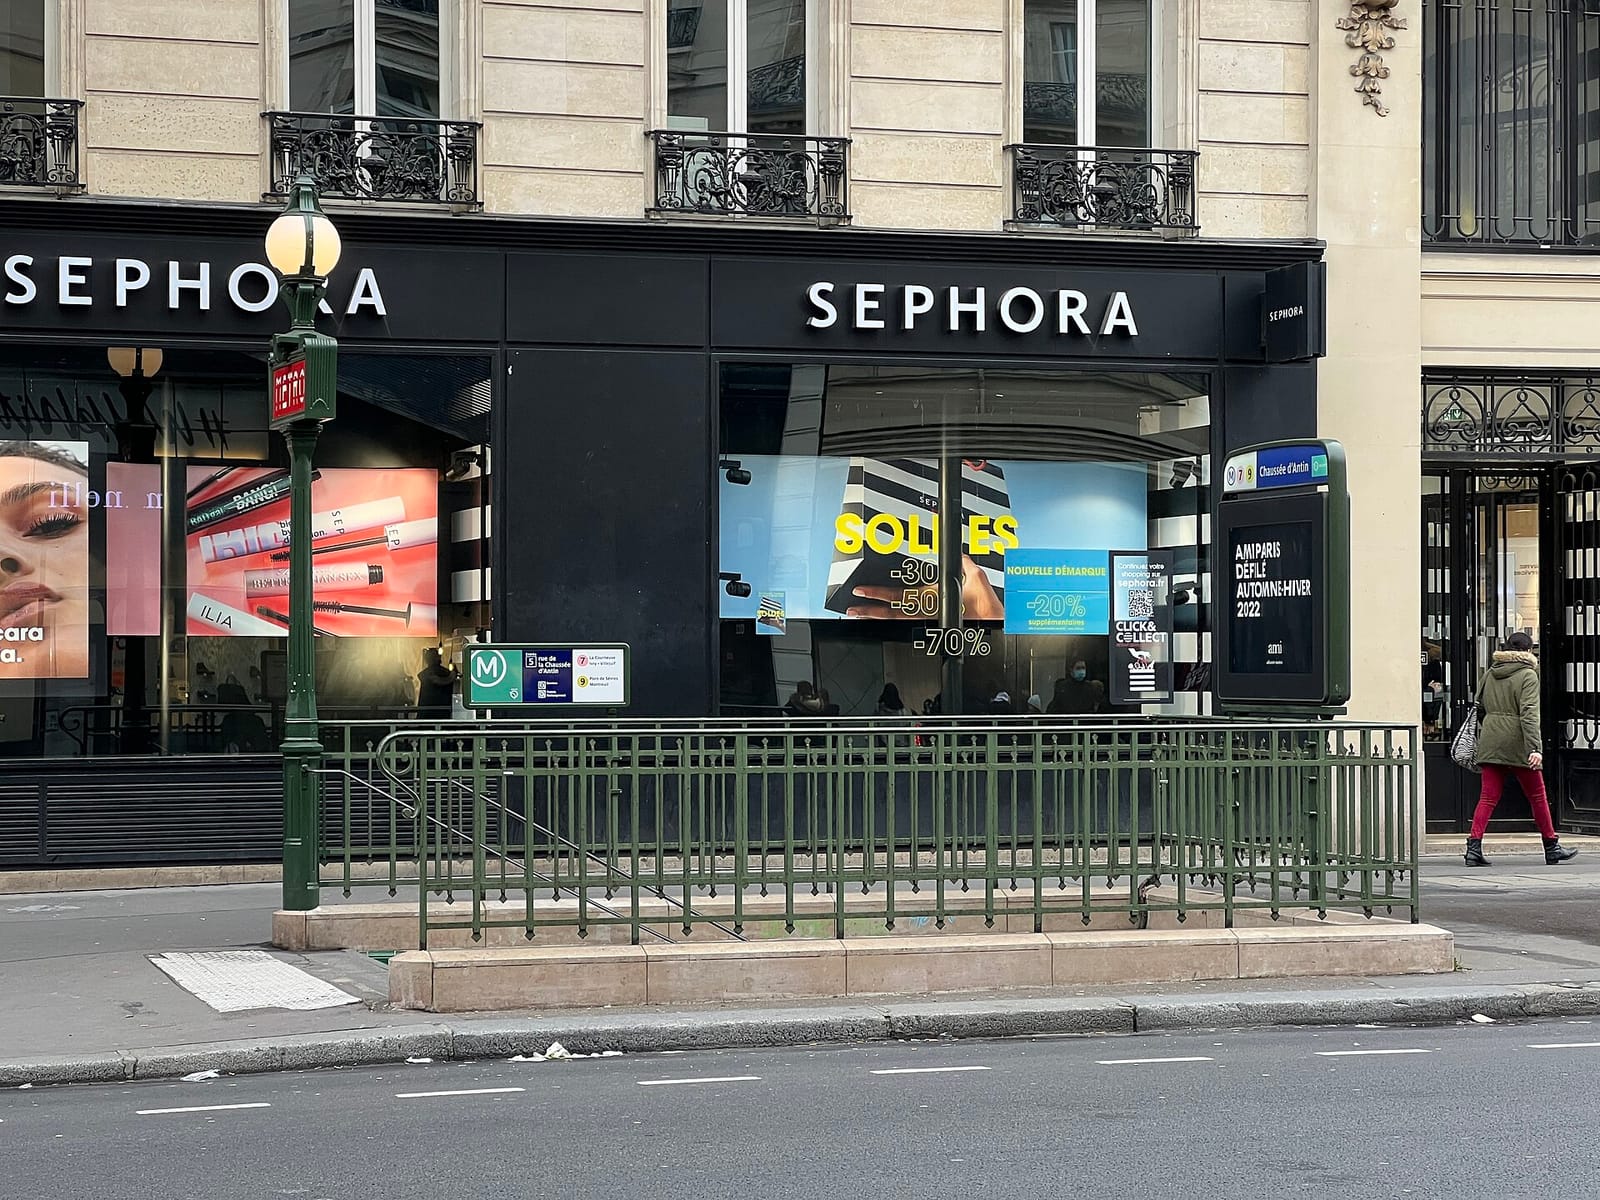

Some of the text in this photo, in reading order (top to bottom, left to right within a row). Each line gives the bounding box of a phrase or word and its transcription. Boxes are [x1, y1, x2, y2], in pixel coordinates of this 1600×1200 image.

[4, 254, 388, 316] SEPHOA
[806, 281, 1139, 336] SEPHORA
[1269, 305, 1304, 322] SEPHORA
[1238, 469, 1243, 481] 7
[1247, 468, 1252, 480] 9
[1259, 461, 1287, 477] Chaussée
[1287, 460, 1309, 474] d'Antin
[834, 512, 1019, 555] SOLES
[1235, 541, 1281, 560] AMI PARIS
[1006, 564, 1106, 577] NOUVELLE DÉMARQUE
[1121, 571, 1150, 579] shopping
[1235, 558, 1267, 579] DÉFILÉ
[1119, 578, 1165, 588] sephora.fr
[1236, 579, 1312, 599] AUTOMNE-HIVER
[200, 605, 233, 629] ILIA
[1236, 600, 1261, 618] 2022
[1115, 621, 1157, 631] CLICK&
[913, 628, 991, 656] -70%
[1267, 640, 1283, 655] ami
[476, 656, 498, 679] M
[528, 657, 534, 666] 5
[580, 656, 586, 665] 7
[580, 677, 586, 686] 9
